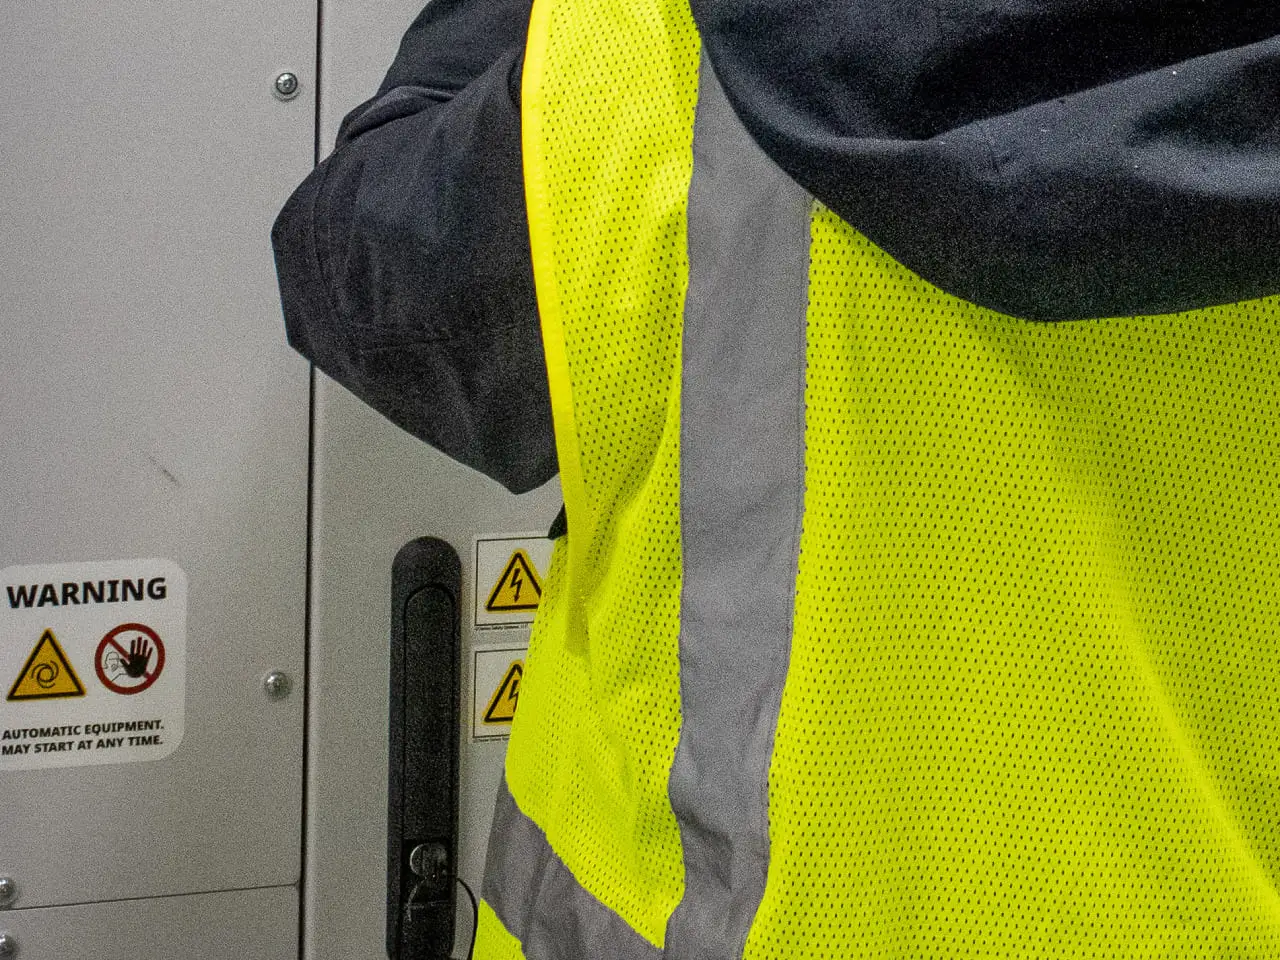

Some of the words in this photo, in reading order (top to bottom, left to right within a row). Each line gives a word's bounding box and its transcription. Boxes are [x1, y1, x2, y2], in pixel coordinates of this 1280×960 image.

[6, 577, 167, 609] WARNING
[2, 725, 81, 740] AUTOMATIC
[84, 720, 164, 736] EQUIPMENT.
[1, 743, 31, 756] MAY
[34, 741, 73, 754] START
[76, 740, 92, 751] AT
[96, 738, 123, 749] ANY
[127, 735, 163, 746] TIME.
